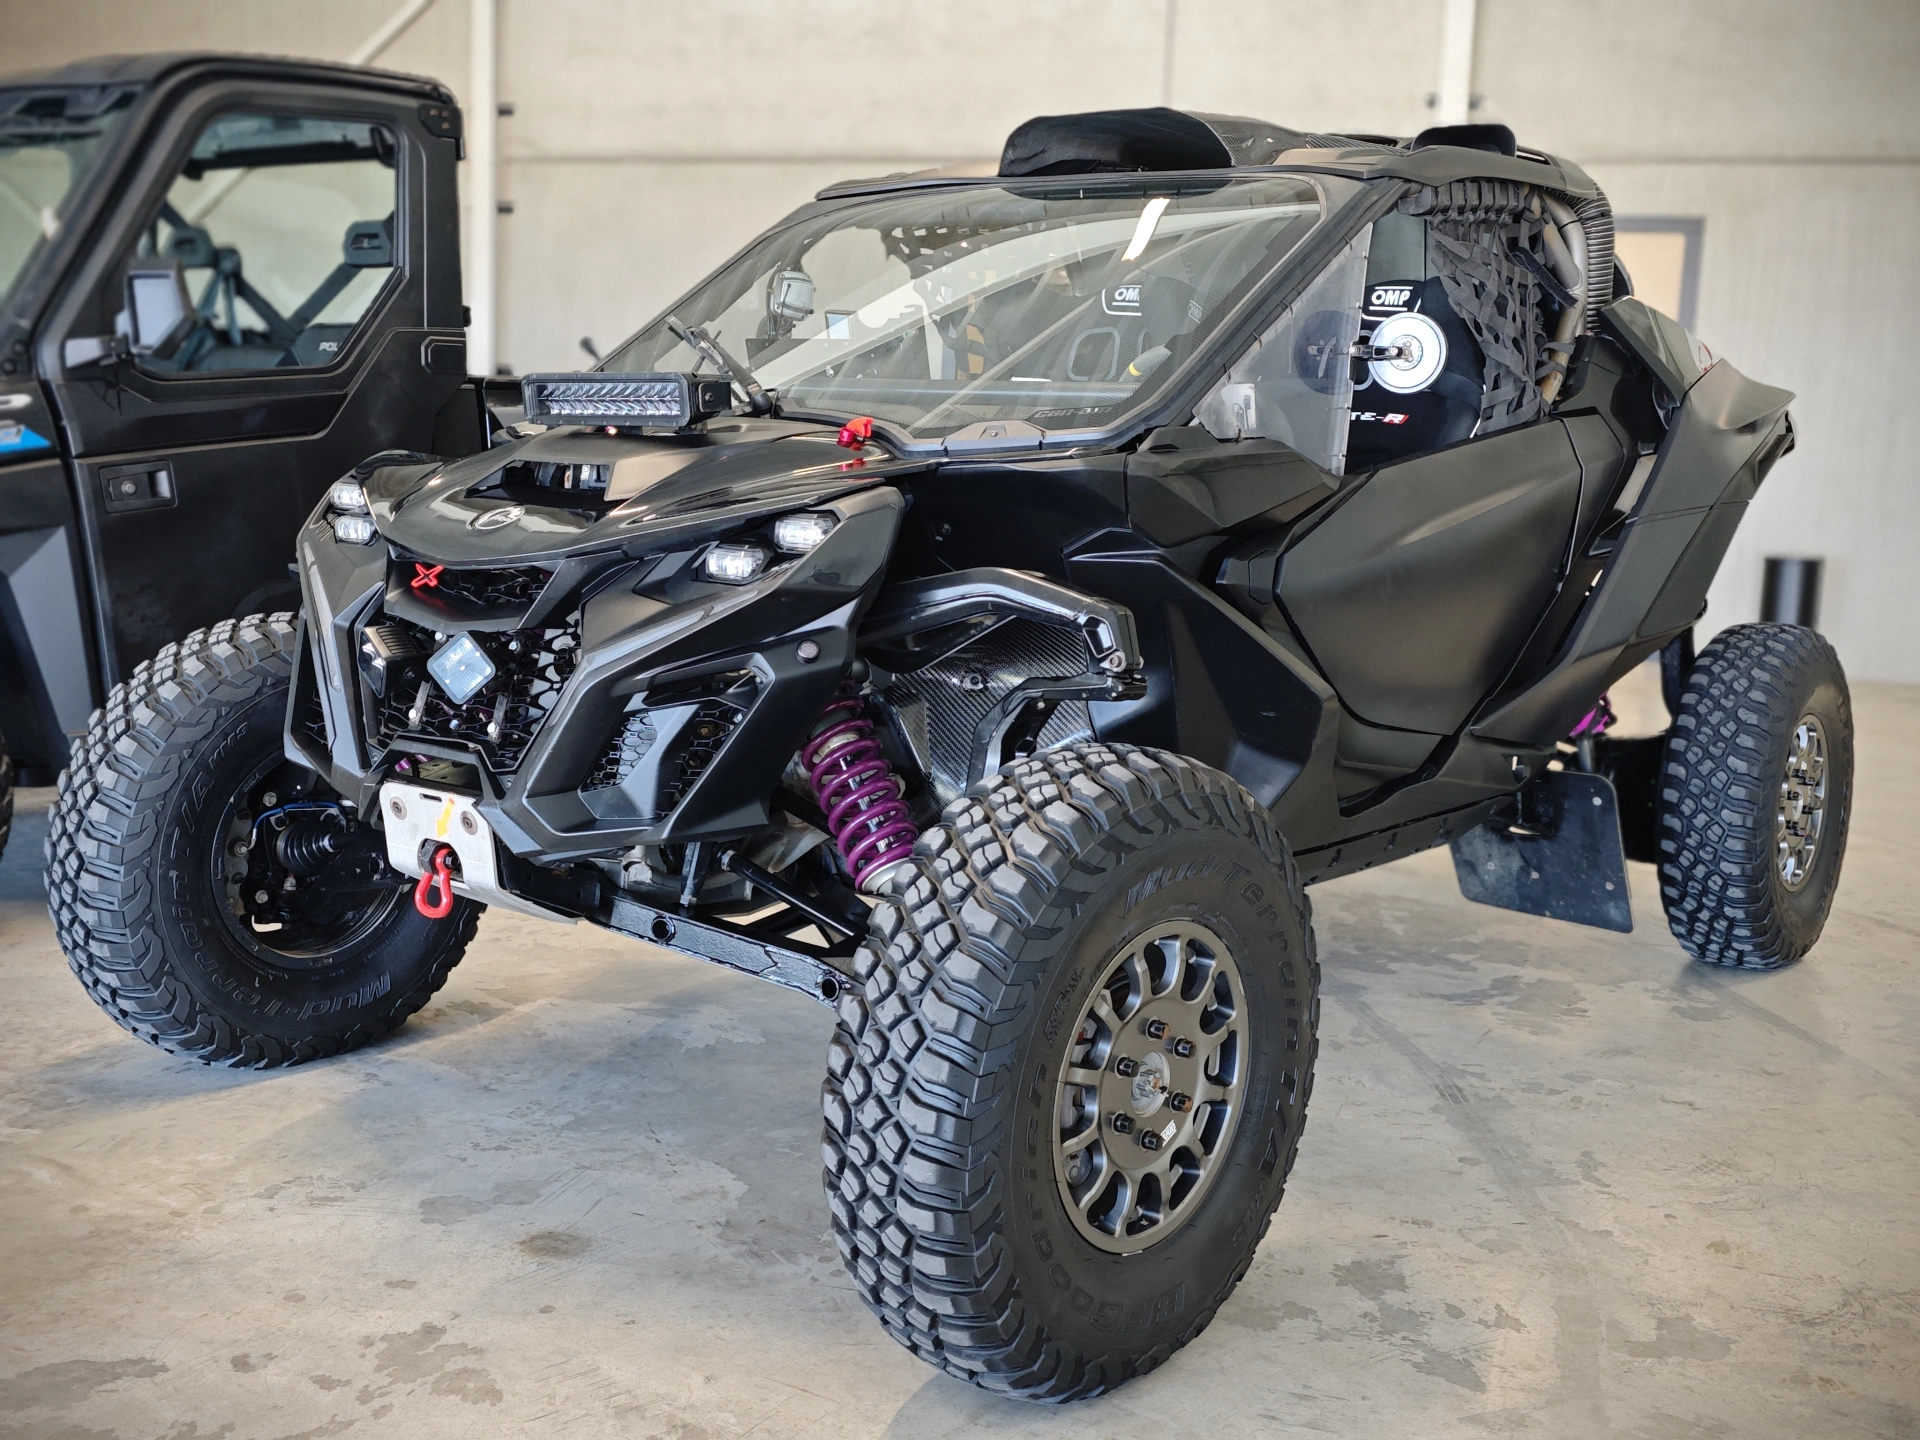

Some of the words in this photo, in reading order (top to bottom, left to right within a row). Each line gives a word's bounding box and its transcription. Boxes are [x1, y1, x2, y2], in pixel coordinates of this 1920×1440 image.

[318, 341, 343, 352] POL
[1370, 289, 1412, 306] OMP
[1122, 853, 1300, 1052] Mud-Terrain
[1020, 1060, 1187, 1333] BFGoodrich
